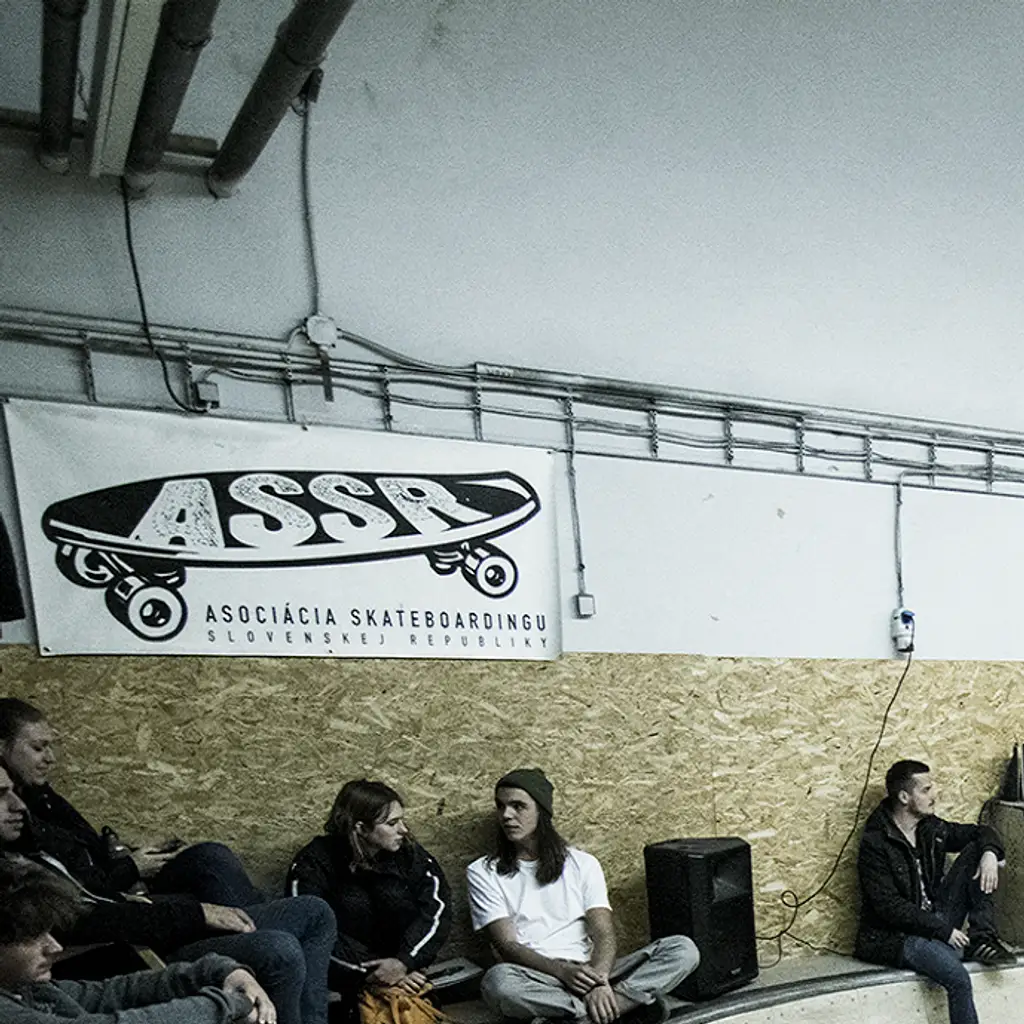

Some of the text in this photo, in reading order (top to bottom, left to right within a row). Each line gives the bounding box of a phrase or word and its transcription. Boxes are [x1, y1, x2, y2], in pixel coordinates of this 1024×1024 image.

[129, 472, 494, 550] ASSR
[205, 602, 547, 632] ASOCIÁCIA SKATEBOARDINGU
[207, 629, 548, 649] SLOVENSKEJ REPUBLIKY
